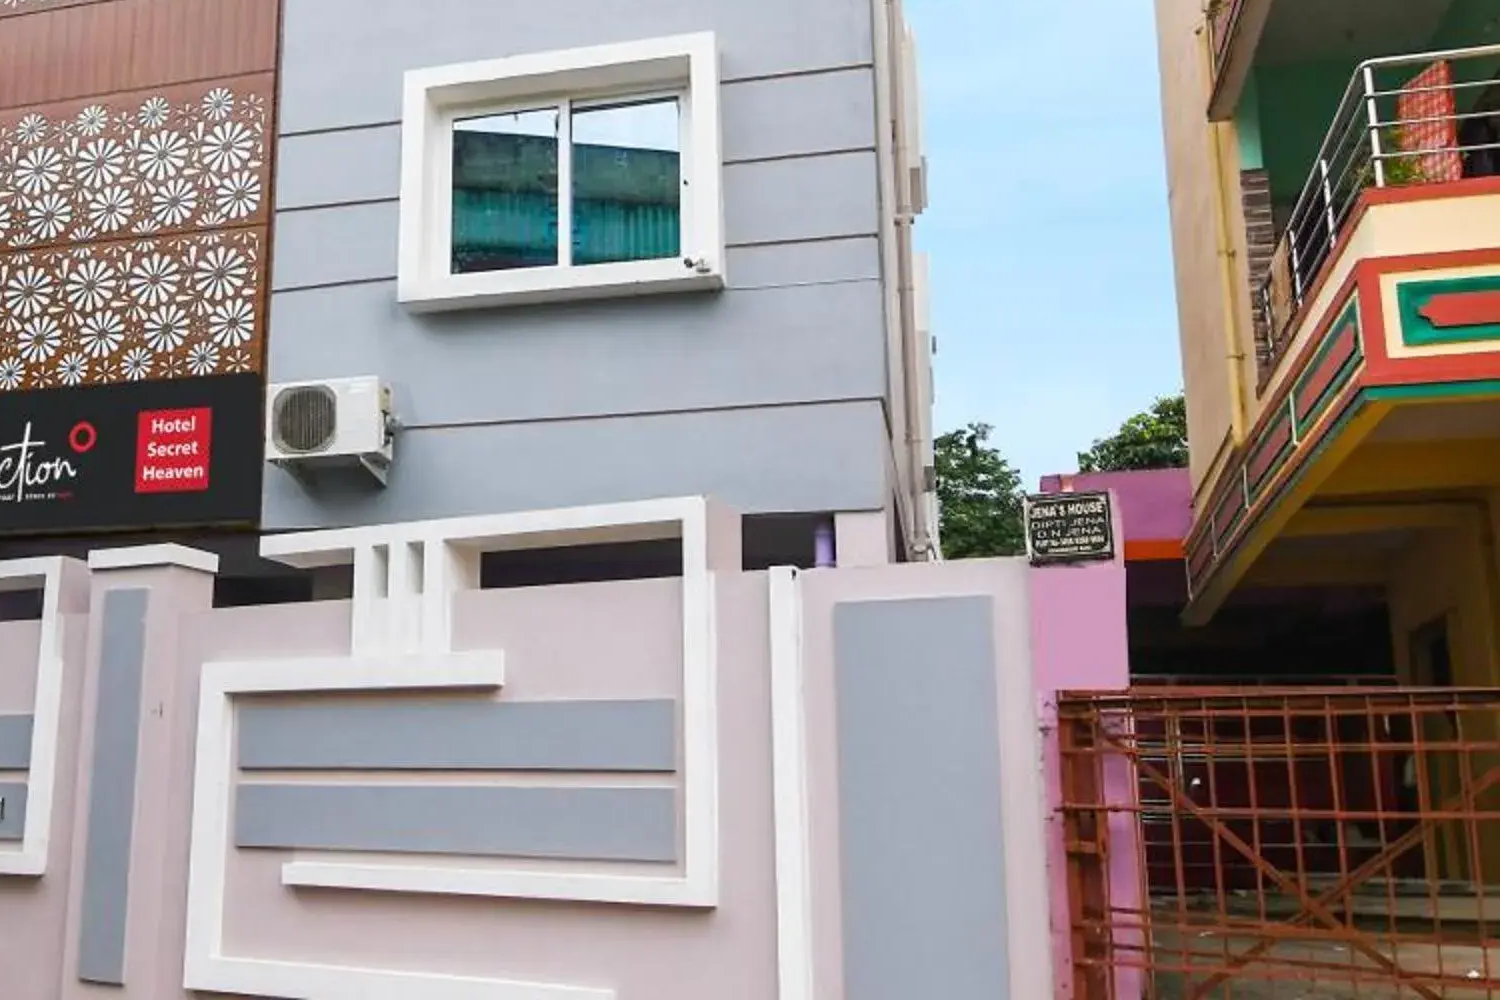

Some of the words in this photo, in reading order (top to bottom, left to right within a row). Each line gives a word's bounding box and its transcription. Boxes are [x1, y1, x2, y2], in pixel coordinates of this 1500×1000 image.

[151, 415, 197, 434] Hotel
[147, 440, 199, 457] Secret
[142, 465, 204, 481] Heaven
[1067, 501, 1103, 515] HOUSE
